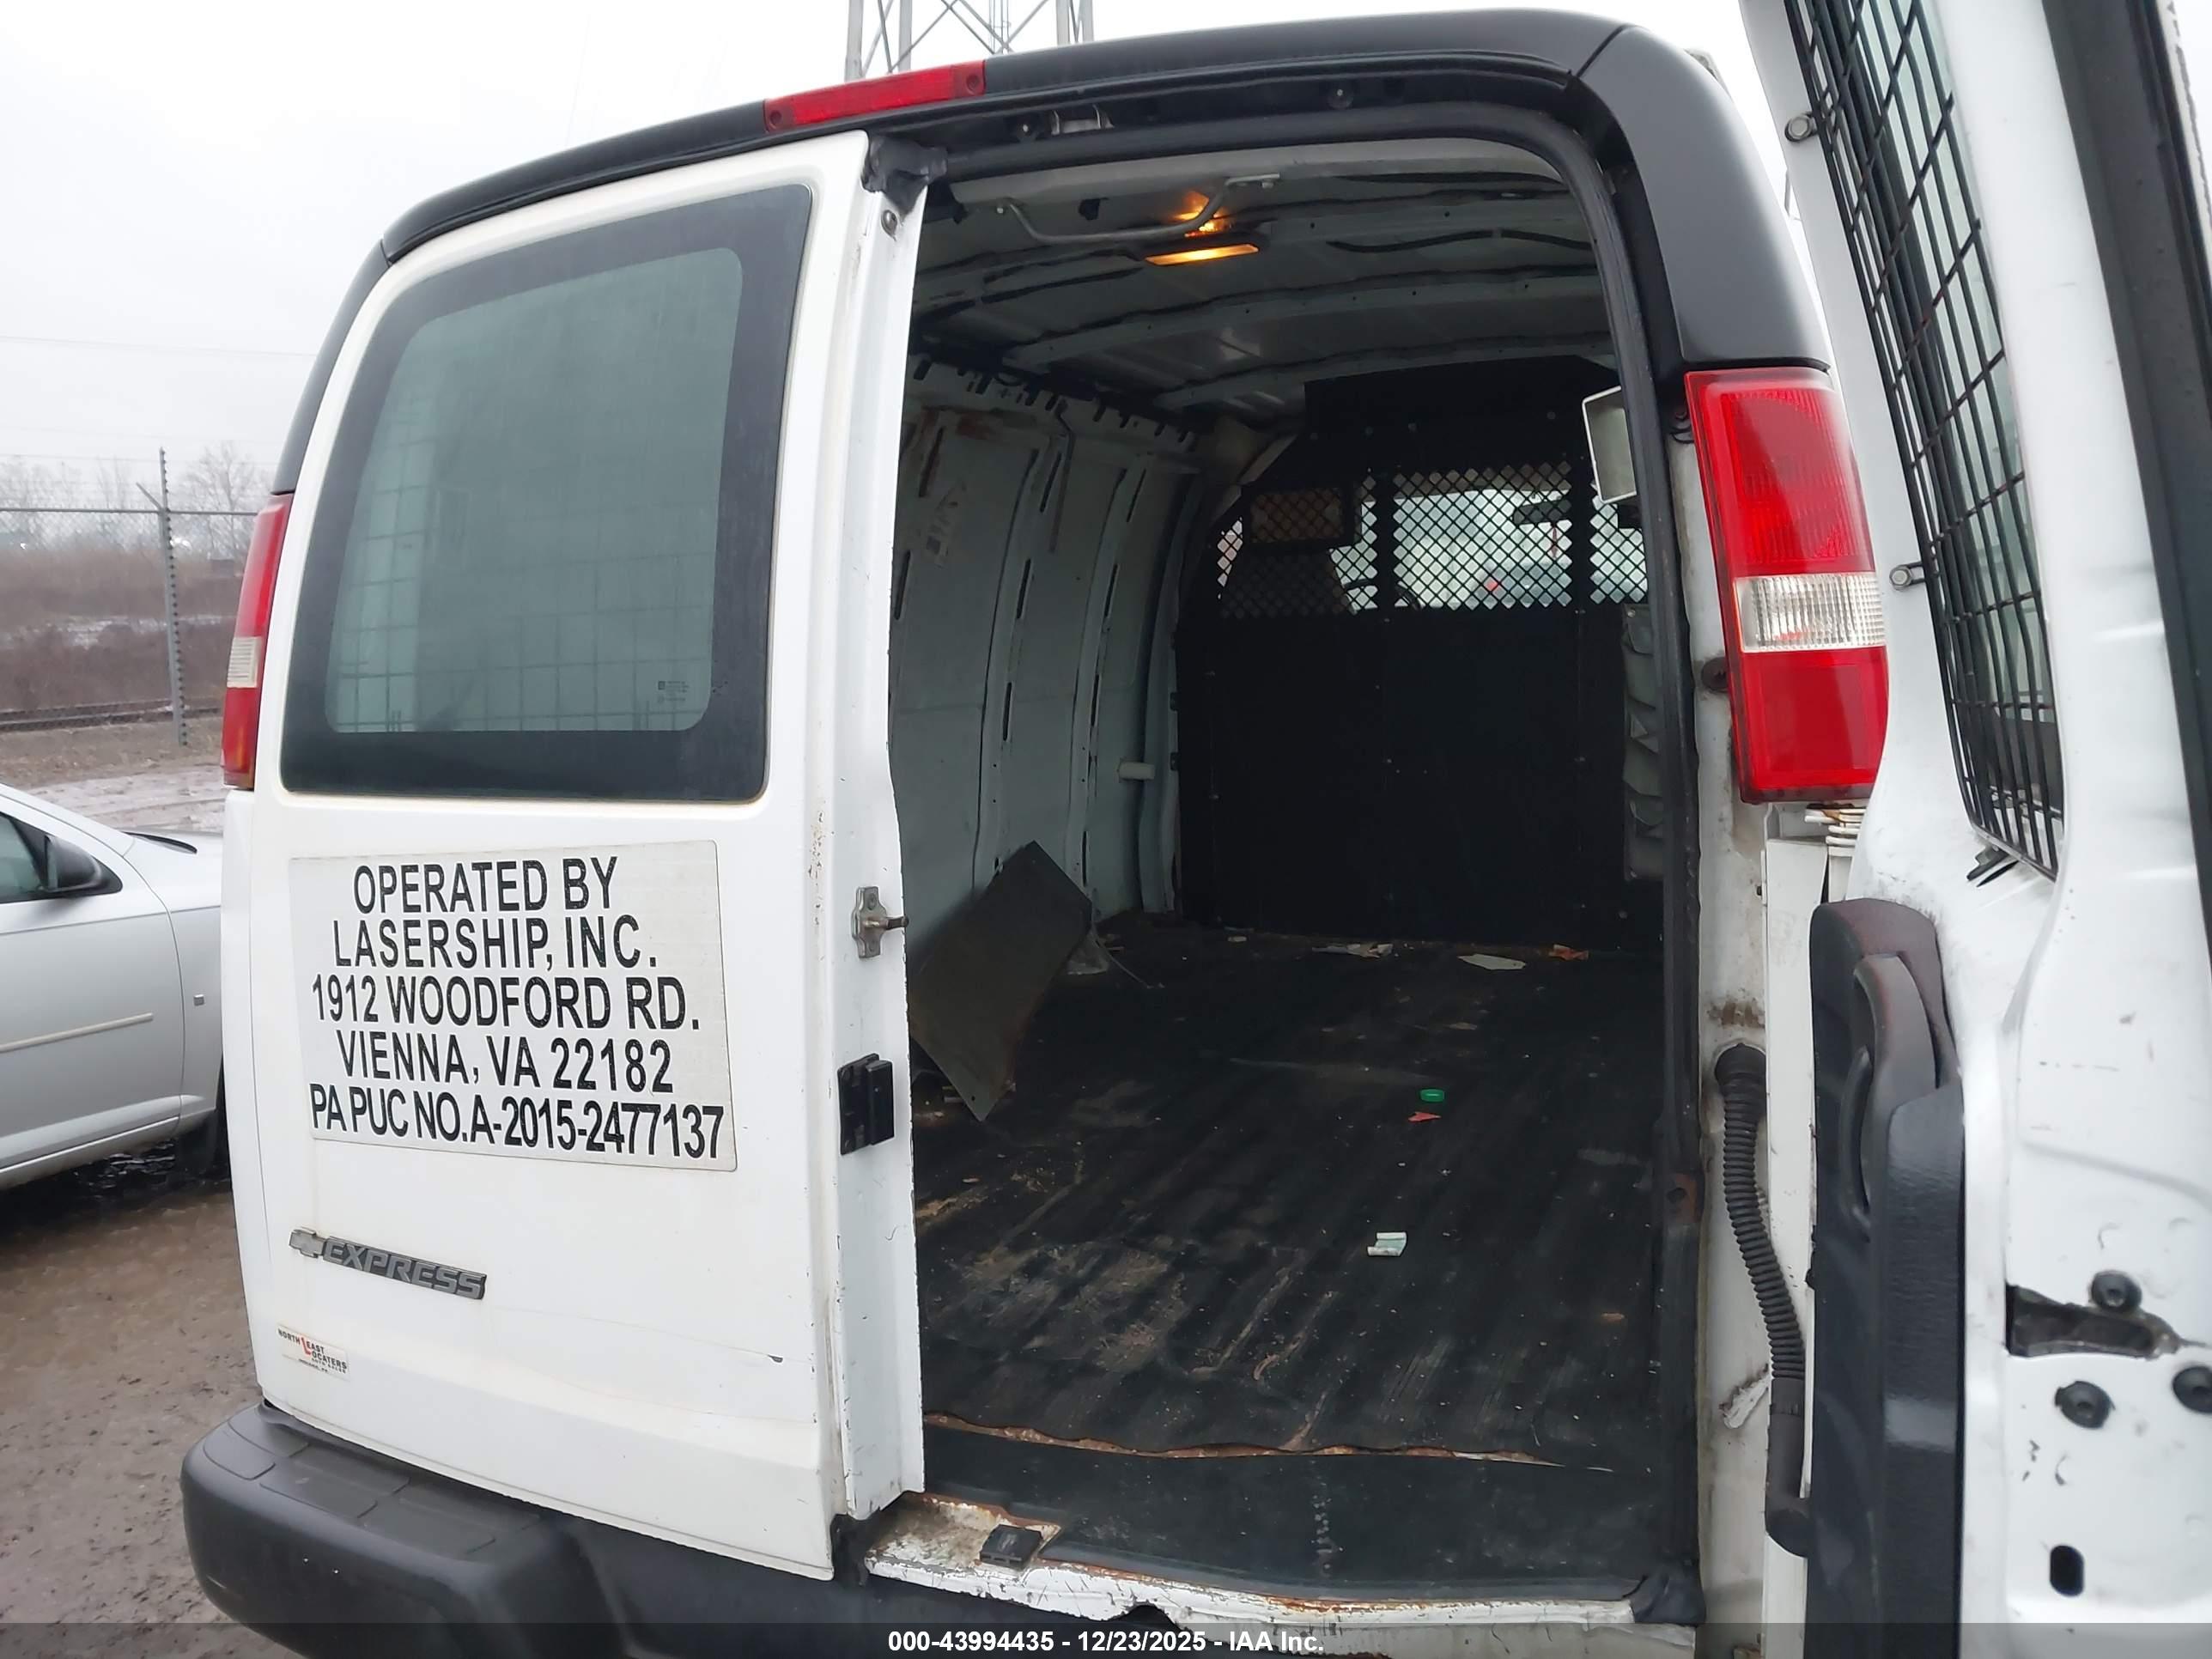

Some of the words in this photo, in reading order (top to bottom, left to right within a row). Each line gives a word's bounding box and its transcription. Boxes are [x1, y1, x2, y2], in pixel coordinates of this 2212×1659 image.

[353, 860, 548, 915] OPERATED
[564, 856, 618, 909] BY
[333, 916, 554, 972] LASERSHIP,
[567, 915, 657, 969] INC.
[312, 973, 380, 1023] 1912
[386, 975, 611, 1030] WOODFORD
[626, 976, 700, 1030] RD.
[337, 1029, 480, 1085] VIENNA,
[486, 1036, 541, 1088] VA
[550, 1036, 674, 1094] 22182
[309, 1083, 348, 1132] PA
[349, 1085, 409, 1138] PUC
[323, 1237, 486, 1300] EXPRESS
[277, 1327, 301, 1346] NORTH
[306, 1340, 325, 1356] EAST
